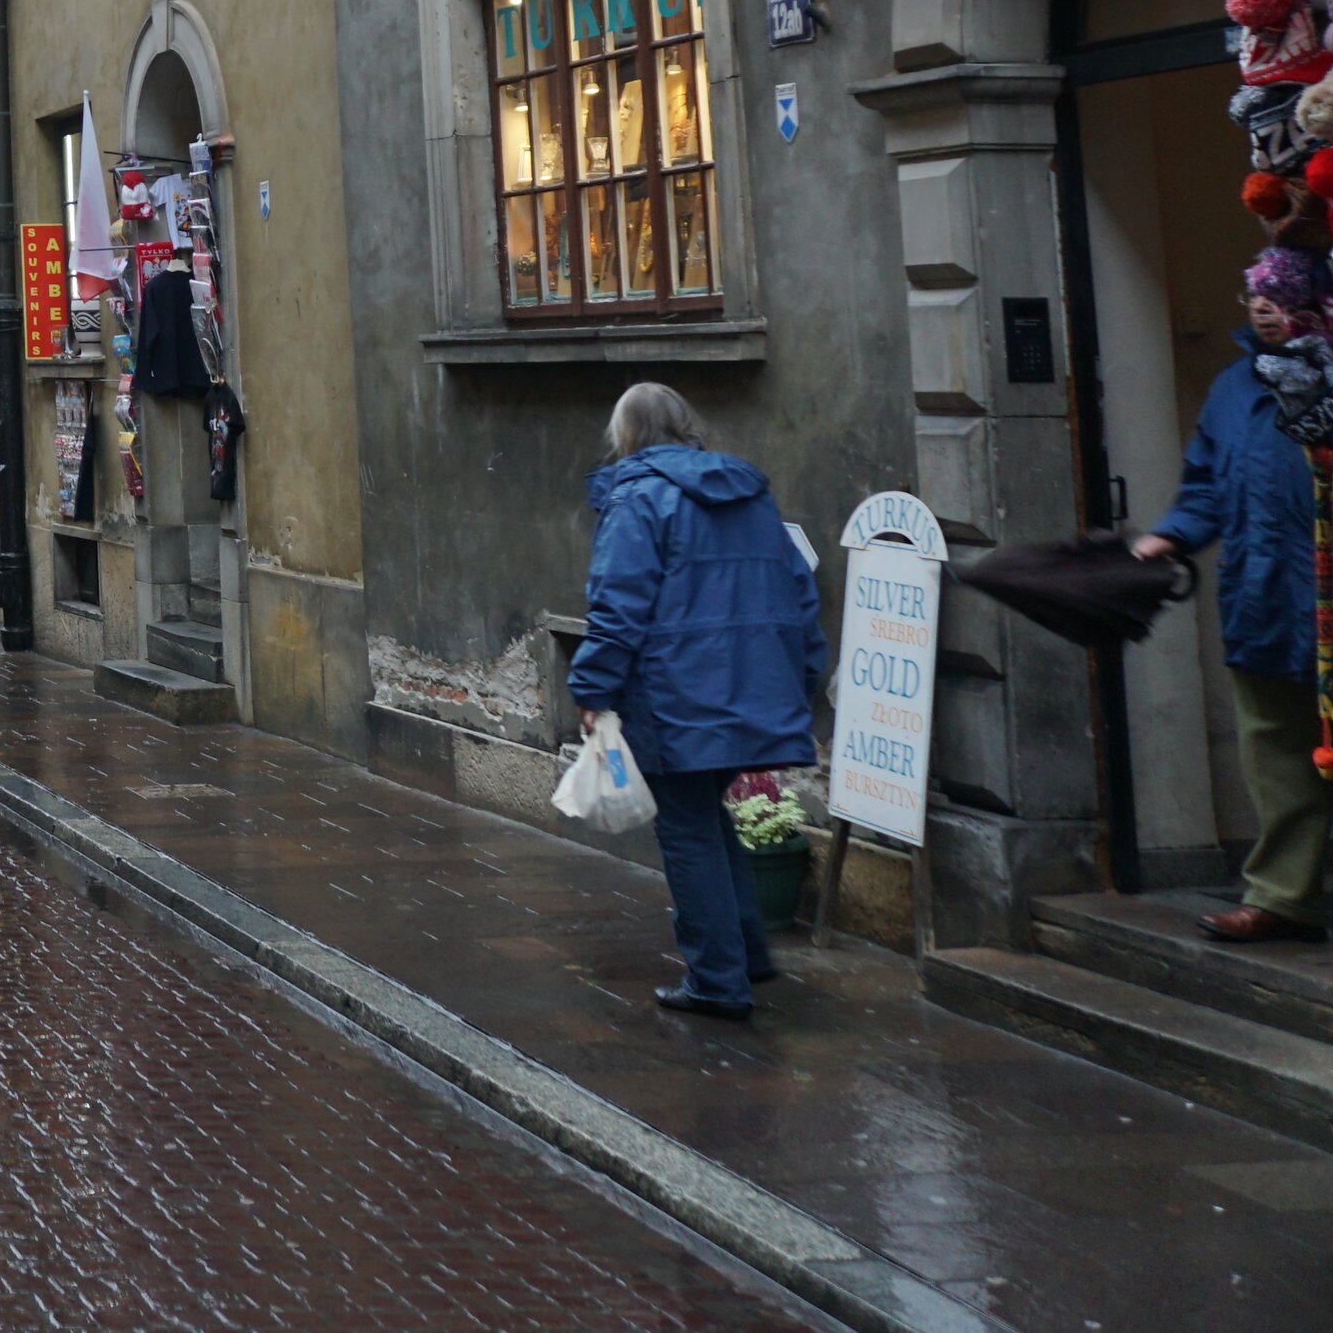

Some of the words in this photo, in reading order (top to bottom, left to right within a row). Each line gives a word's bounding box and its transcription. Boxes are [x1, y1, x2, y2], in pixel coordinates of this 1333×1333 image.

[772, 0, 804, 40] 12ab
[27, 228, 41, 356] SOUVENIRS
[852, 496, 937, 555] TURKUS
[856, 575, 925, 620] SILVER
[870, 617, 929, 648] SREBRO
[851, 647, 920, 699] GOLD
[843, 729, 915, 779] AMBER
[845, 769, 918, 811] BURSZTYN
